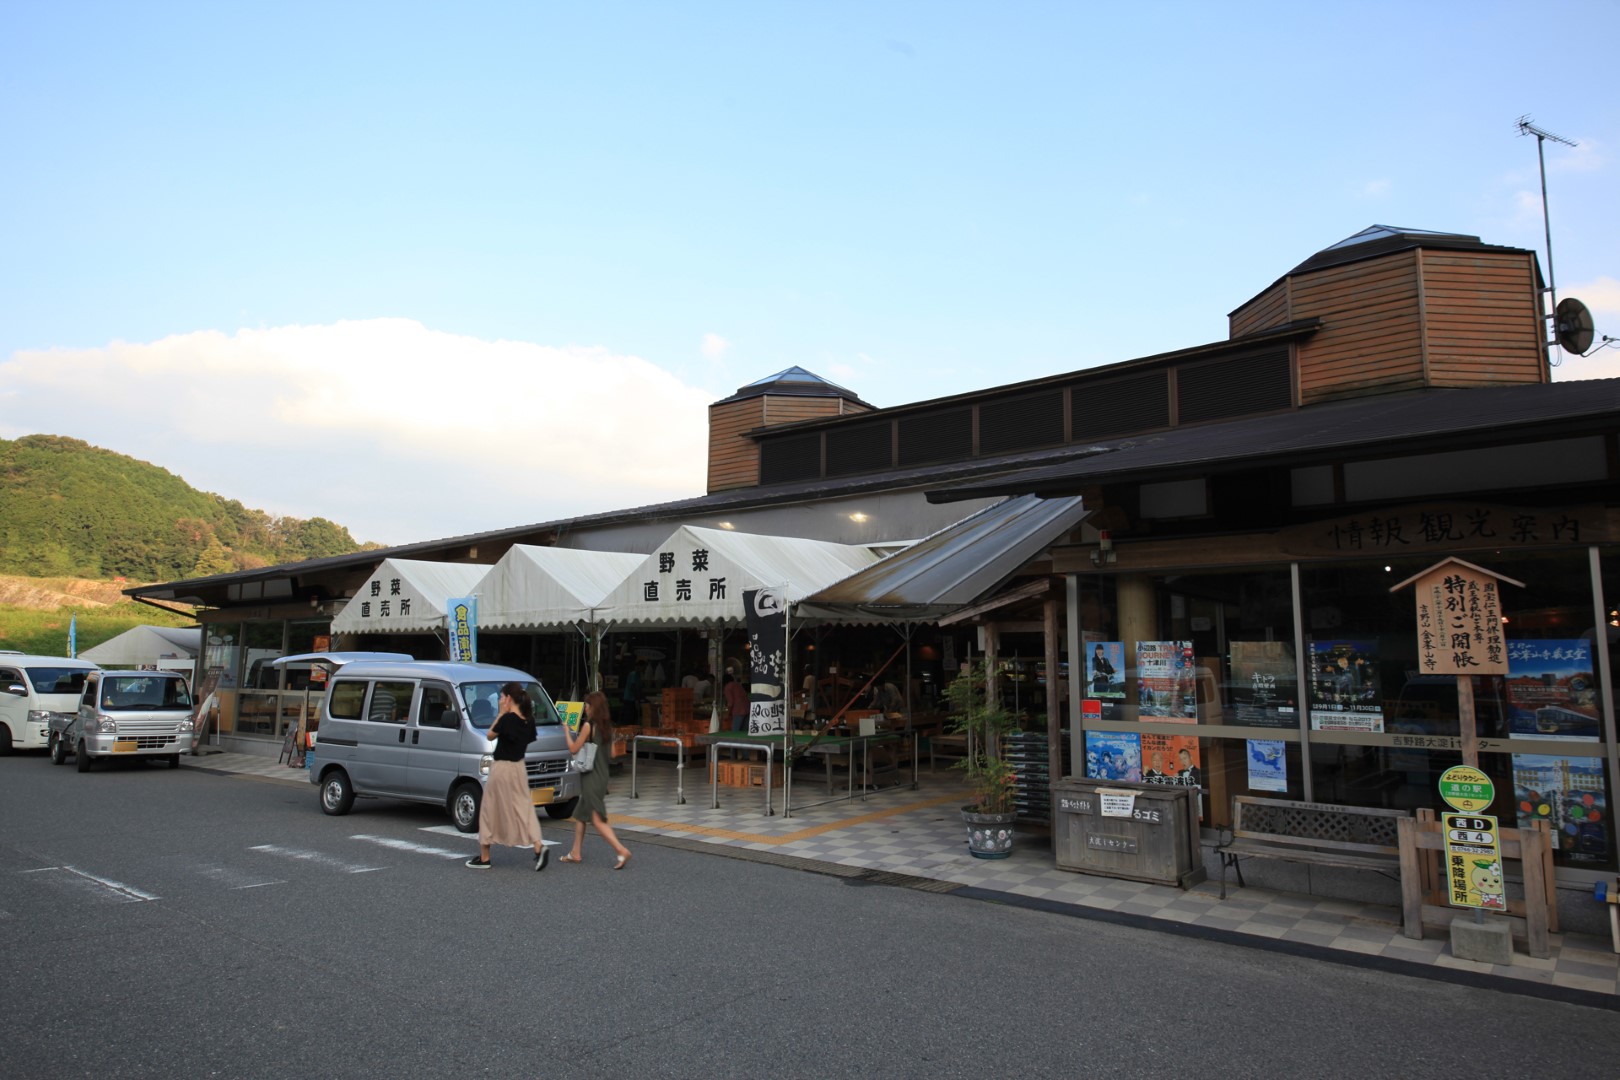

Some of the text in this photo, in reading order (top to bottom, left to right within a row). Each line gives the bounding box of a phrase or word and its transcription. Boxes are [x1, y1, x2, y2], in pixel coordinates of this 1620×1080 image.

[659, 549, 708, 573] 野菜
[371, 578, 400, 597] 野菜
[644, 577, 726, 601] 直売所
[362, 598, 410, 617] 直売所
[1443, 574, 1480, 668] 特別ご開帳
[1251, 672, 1275, 683] キトラ
[1451, 783, 1482, 793] 道の駅
[1455, 818, 1484, 830] 西 D
[1457, 831, 1484, 842] 西 4
[1451, 855, 1468, 903] 乗降場所
